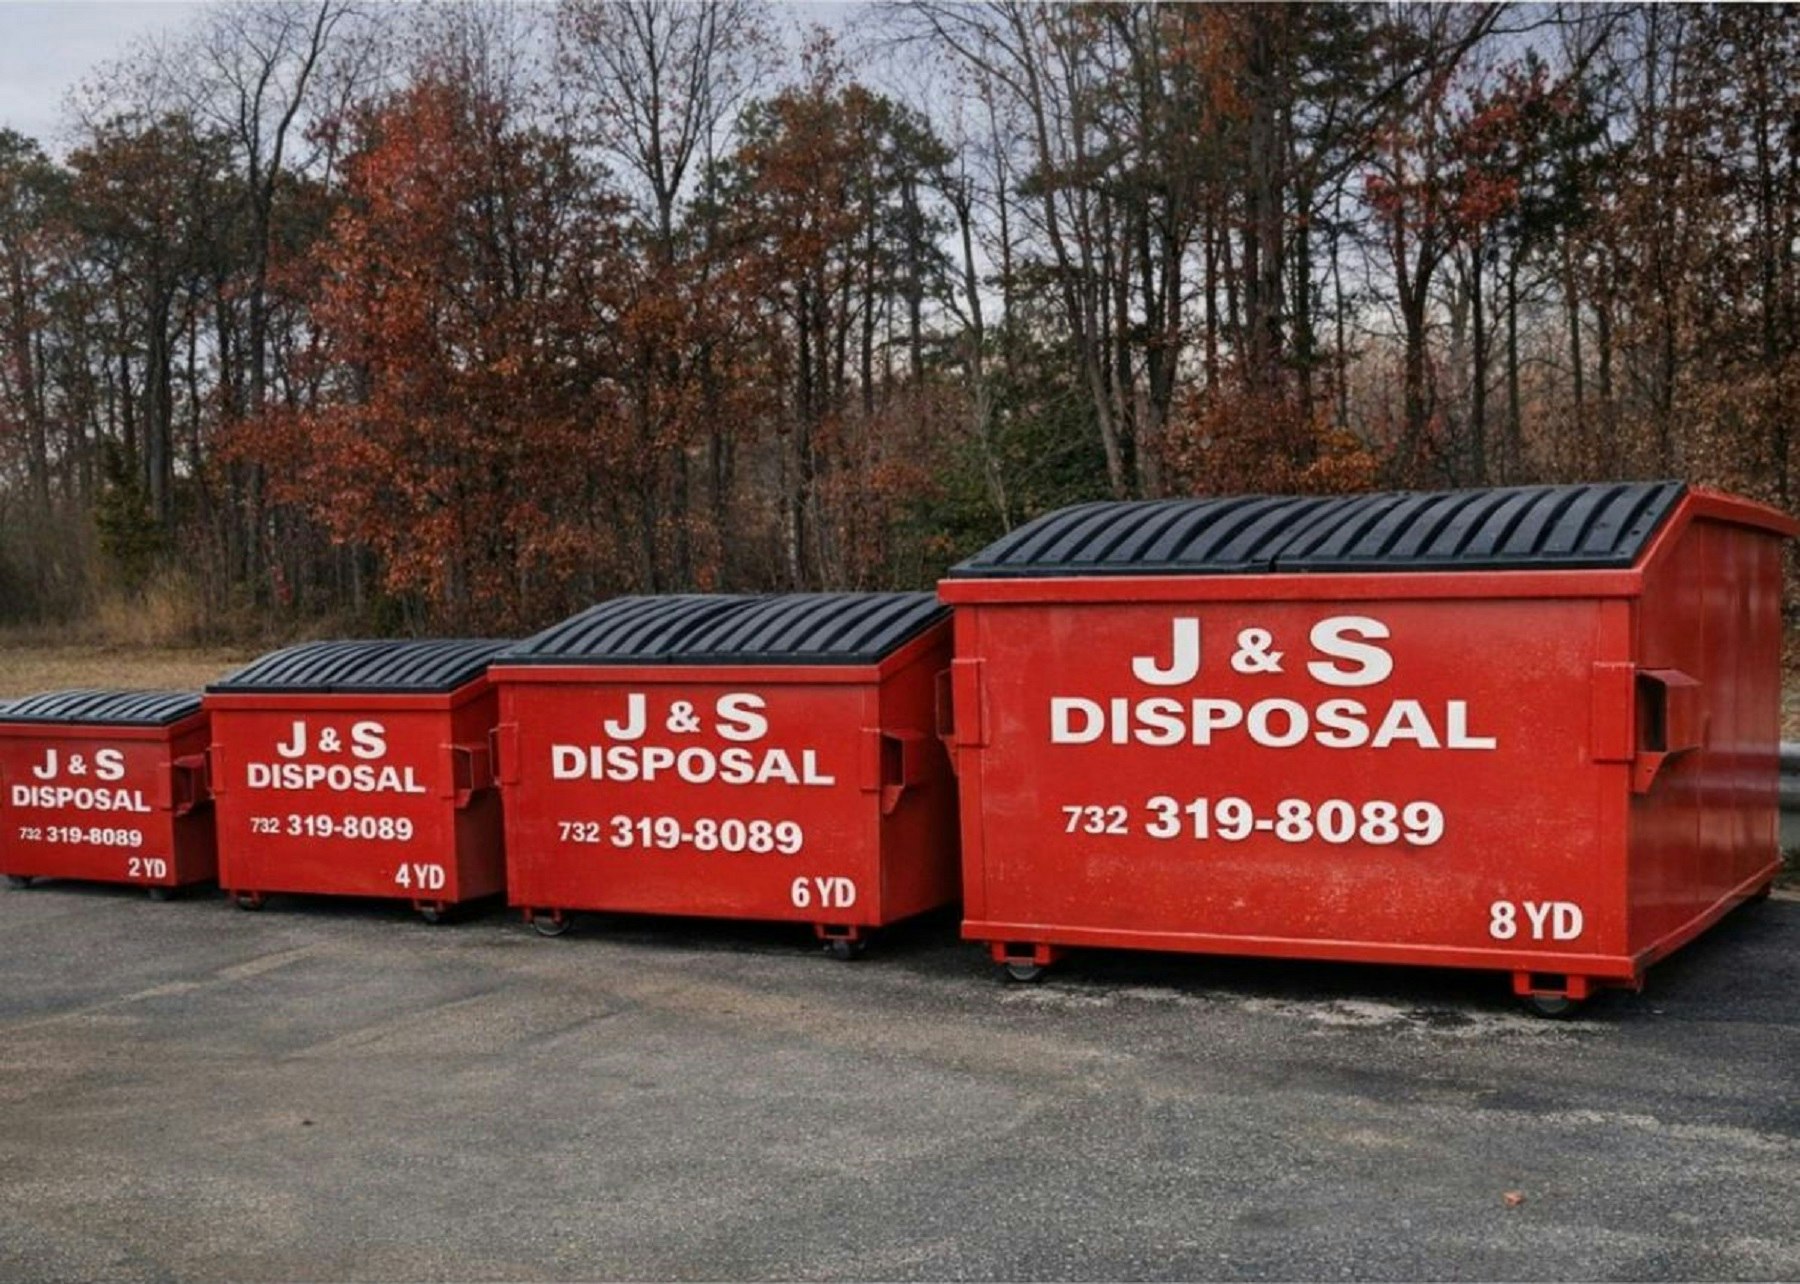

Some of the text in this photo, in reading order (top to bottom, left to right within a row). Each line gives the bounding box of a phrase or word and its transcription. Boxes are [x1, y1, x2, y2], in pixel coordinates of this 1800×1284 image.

[1132, 615, 1393, 686] J & S
[604, 693, 768, 741] J & S
[1050, 697, 1497, 750] DISPOSAL
[277, 721, 387, 759] J & S
[33, 748, 125, 781] J & S
[247, 763, 426, 793] DISPOSAL
[551, 745, 835, 785] DISPOSAL
[12, 785, 151, 812] DISPOSAL
[19, 826, 143, 847] 732 319-8089
[250, 814, 413, 841] 732 319-8089
[558, 815, 803, 855] 732 319-8089
[1062, 795, 1444, 845] 732 319-8089
[129, 857, 167, 878] 2 YD
[395, 863, 445, 890] 4 YD
[791, 877, 856, 908] 6 YD
[1489, 900, 1583, 940] 8 YD
